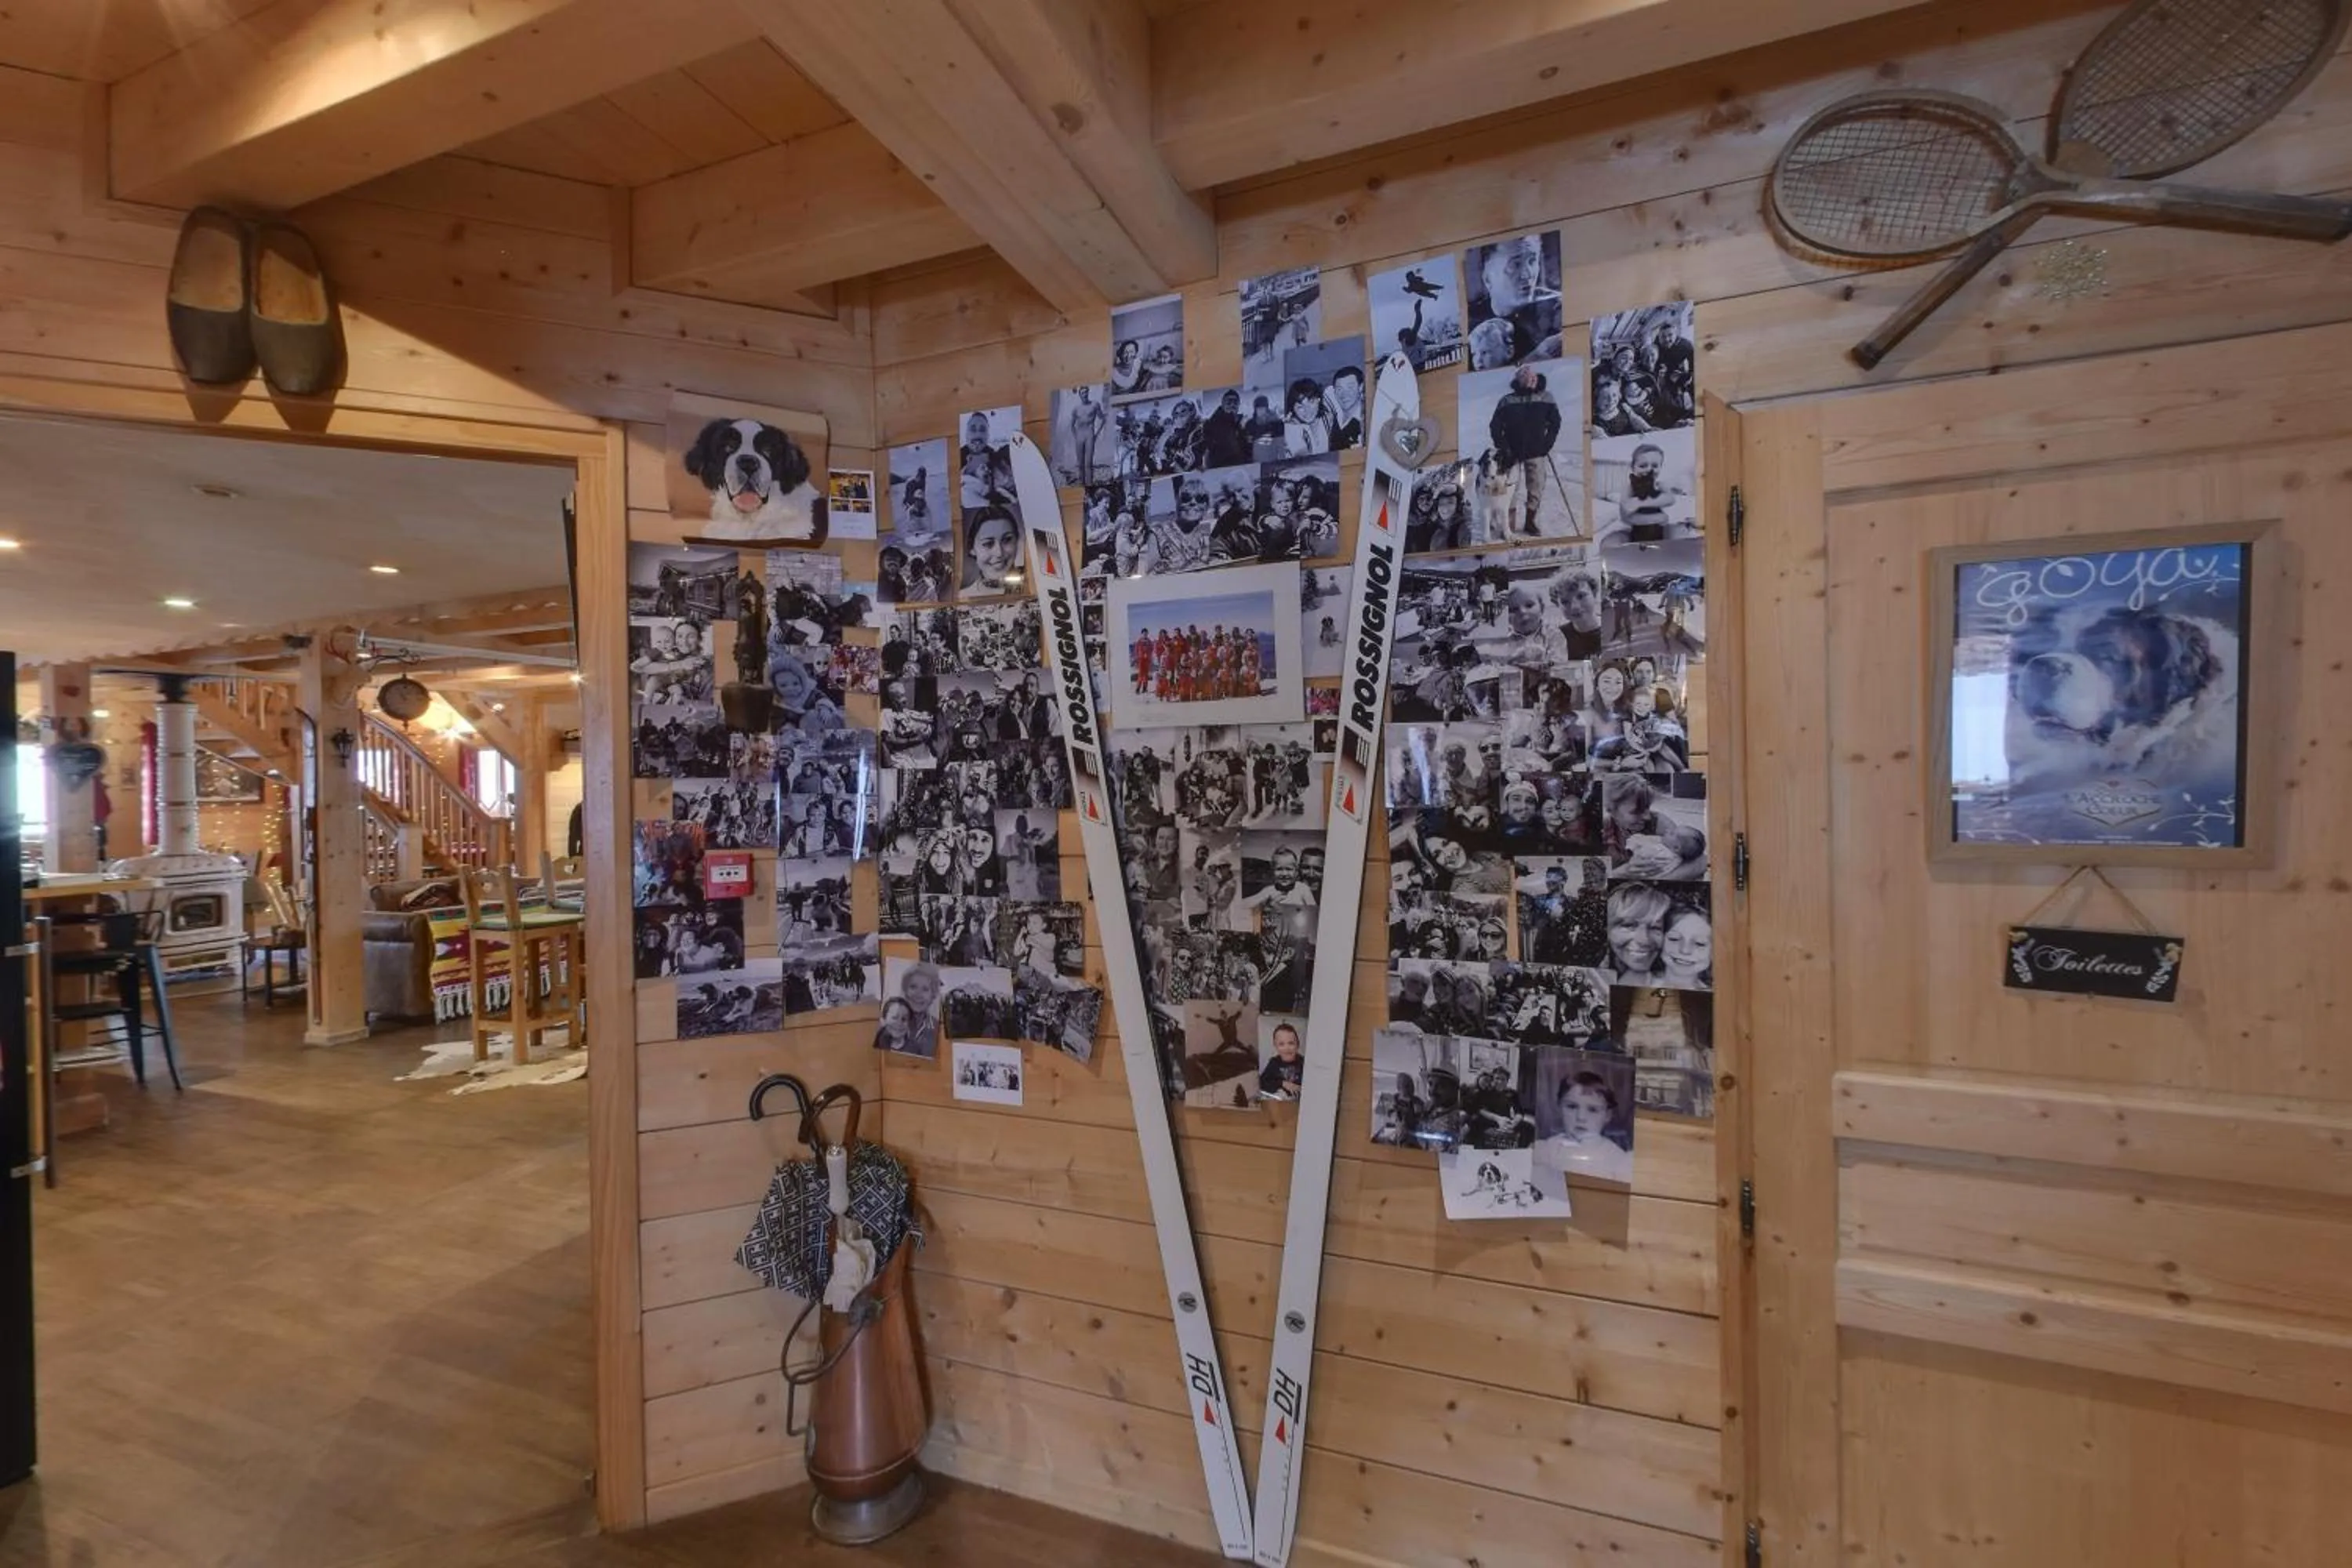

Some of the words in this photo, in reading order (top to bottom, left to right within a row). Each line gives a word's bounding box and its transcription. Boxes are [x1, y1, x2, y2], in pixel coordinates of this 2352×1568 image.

[1048, 586, 1094, 746] ROSSIGNOL
[1351, 543, 1394, 733] ROSSIGNOL
[2031, 945, 2144, 975] Toilettes
